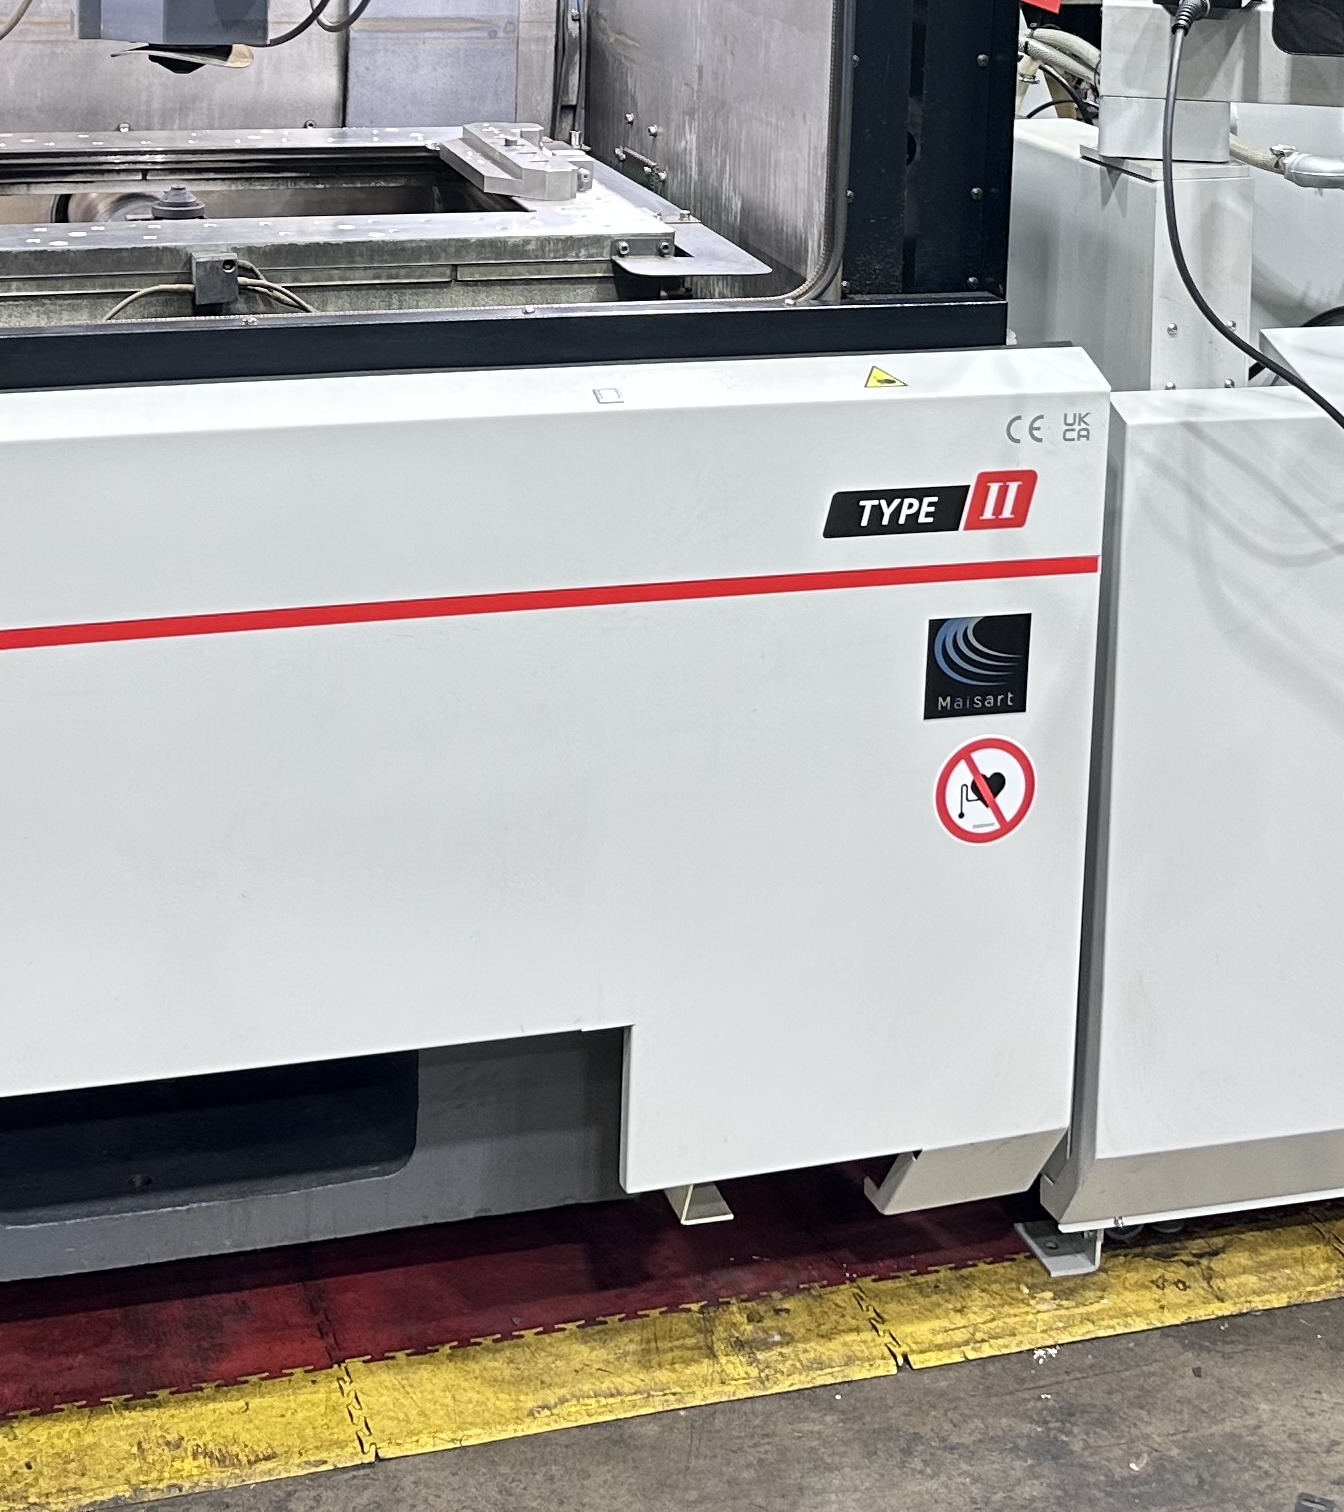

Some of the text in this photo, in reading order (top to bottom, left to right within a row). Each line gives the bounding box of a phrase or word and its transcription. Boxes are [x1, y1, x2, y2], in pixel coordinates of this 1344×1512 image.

[1064, 412, 1091, 426] UK
[1063, 427, 1090, 441] CA
[859, 481, 1022, 527] TYPE II
[937, 691, 1015, 711] Maisart
